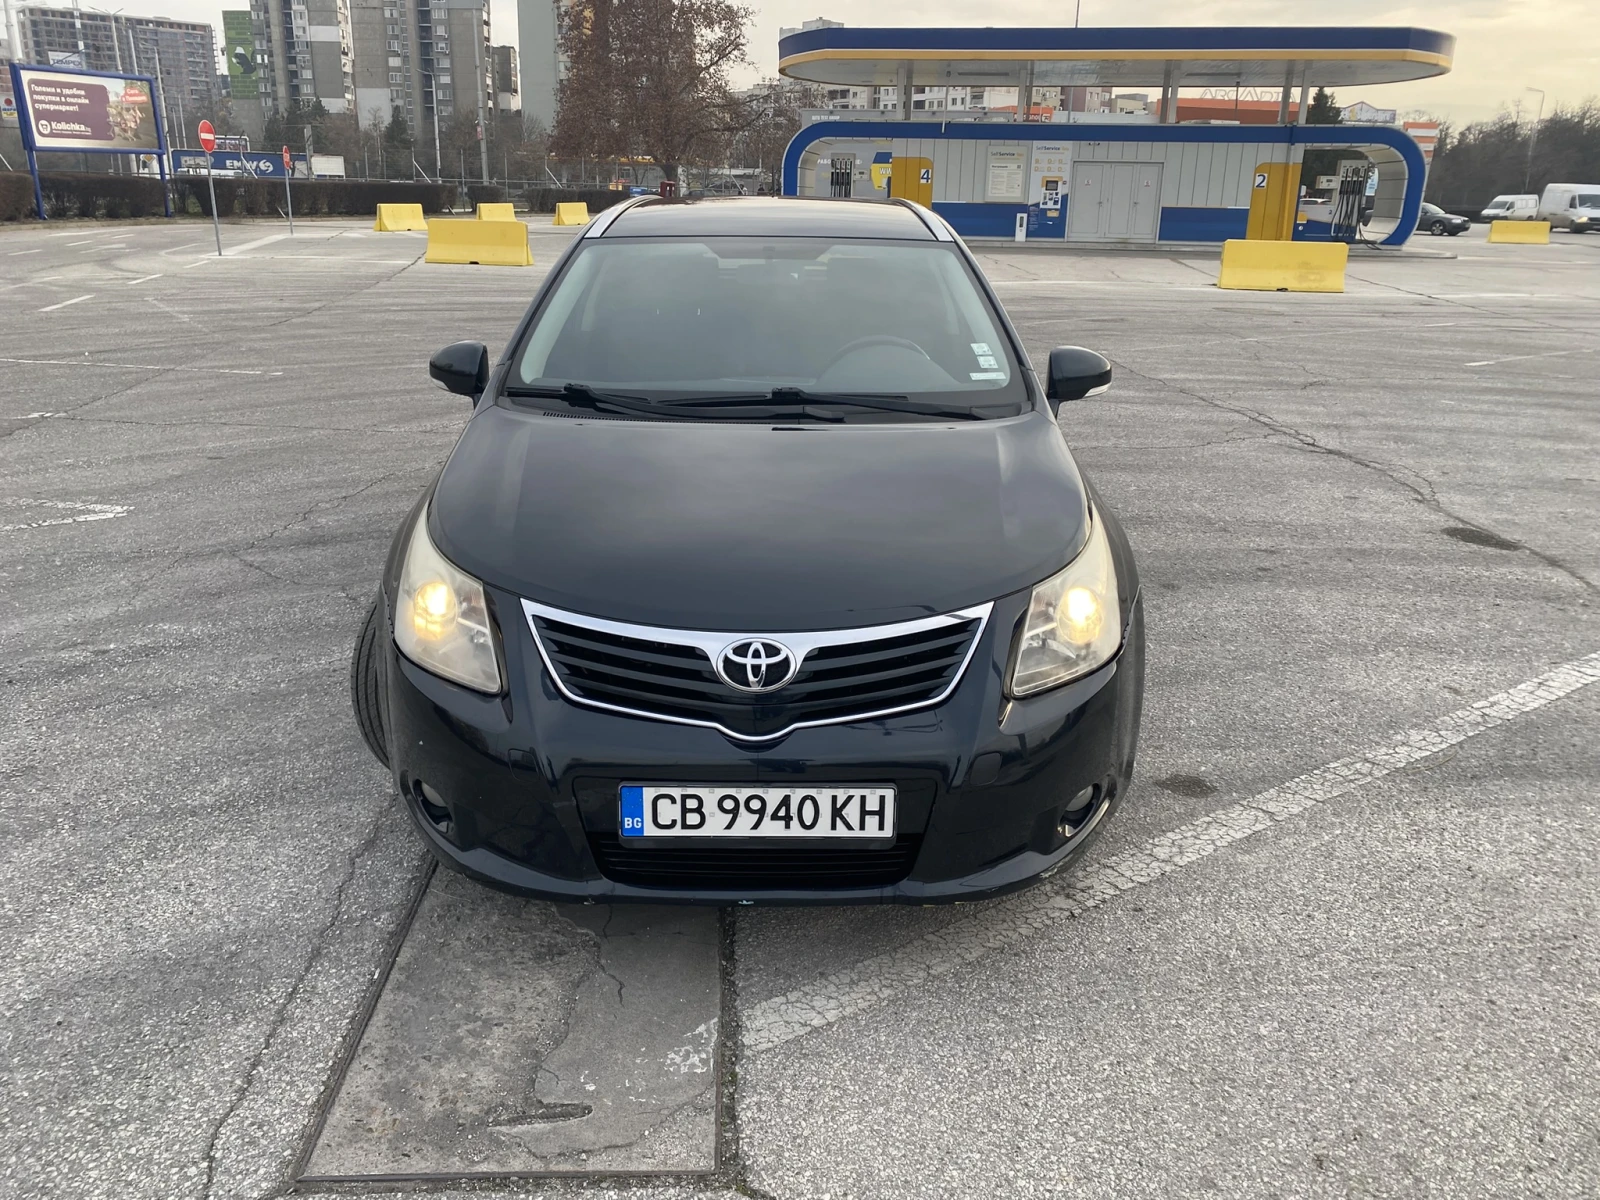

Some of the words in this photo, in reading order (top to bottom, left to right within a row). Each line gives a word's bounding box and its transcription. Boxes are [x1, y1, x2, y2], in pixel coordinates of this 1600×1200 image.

[31, 84, 55, 93] Големи
[61, 88, 86, 96] удобни
[33, 94, 60, 102] покупки
[66, 96, 90, 104] онлайн
[34, 103, 79, 112] супермаркет!
[921, 169, 931, 184] 4
[1255, 174, 1266, 188] 2
[651, 793, 707, 830] CB
[716, 794, 820, 831] 9940
[830, 794, 886, 831] KH
[624, 817, 642, 829] BG
